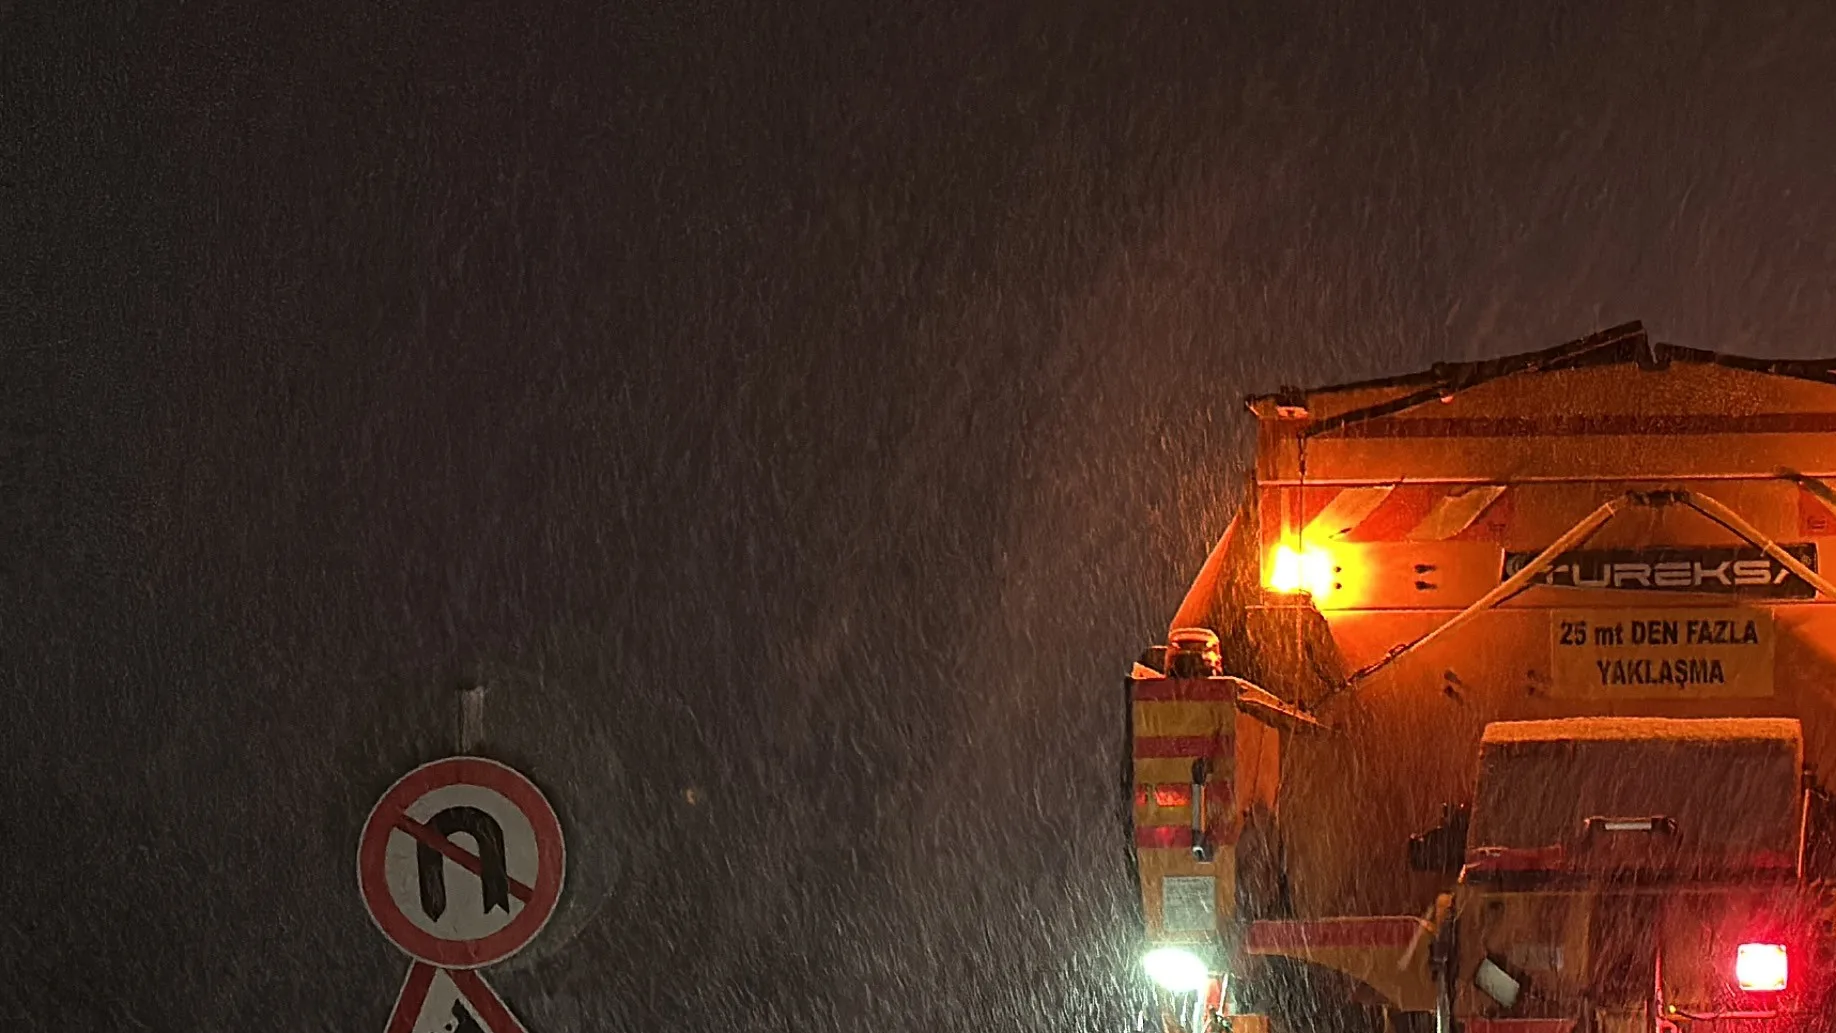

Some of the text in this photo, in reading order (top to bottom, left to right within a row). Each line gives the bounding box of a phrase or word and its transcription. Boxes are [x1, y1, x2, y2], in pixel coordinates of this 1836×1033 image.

[1560, 619, 1759, 645] 25 mt DEN FAZLA
[1597, 659, 1725, 690] YAKLAŞMA
